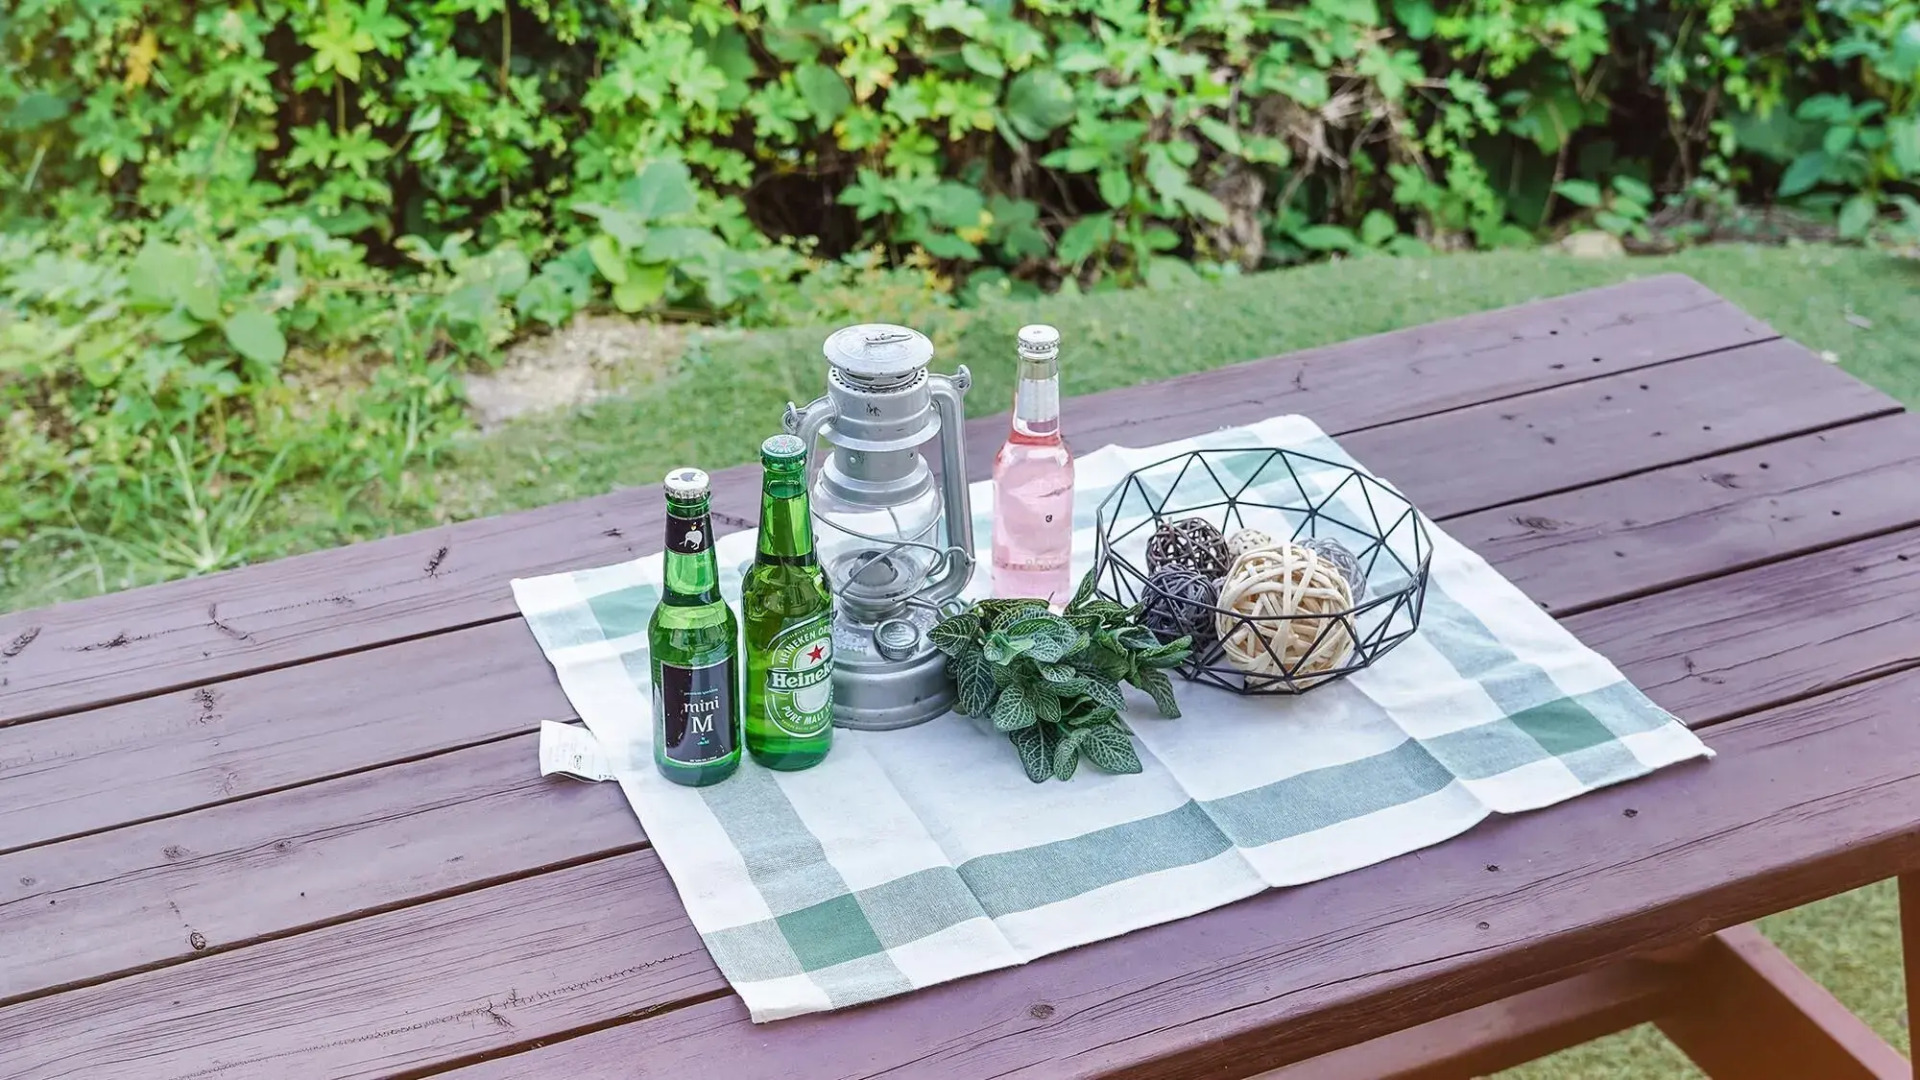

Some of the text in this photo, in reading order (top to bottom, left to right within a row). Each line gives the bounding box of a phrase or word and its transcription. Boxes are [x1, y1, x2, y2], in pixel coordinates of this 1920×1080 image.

[779, 630, 816, 664] HEINEKEN
[771, 658, 834, 688] Heinek
[683, 695, 720, 713] mini
[691, 714, 714, 734] M
[781, 705, 802, 724] PURE
[803, 710, 825, 726] MALT
